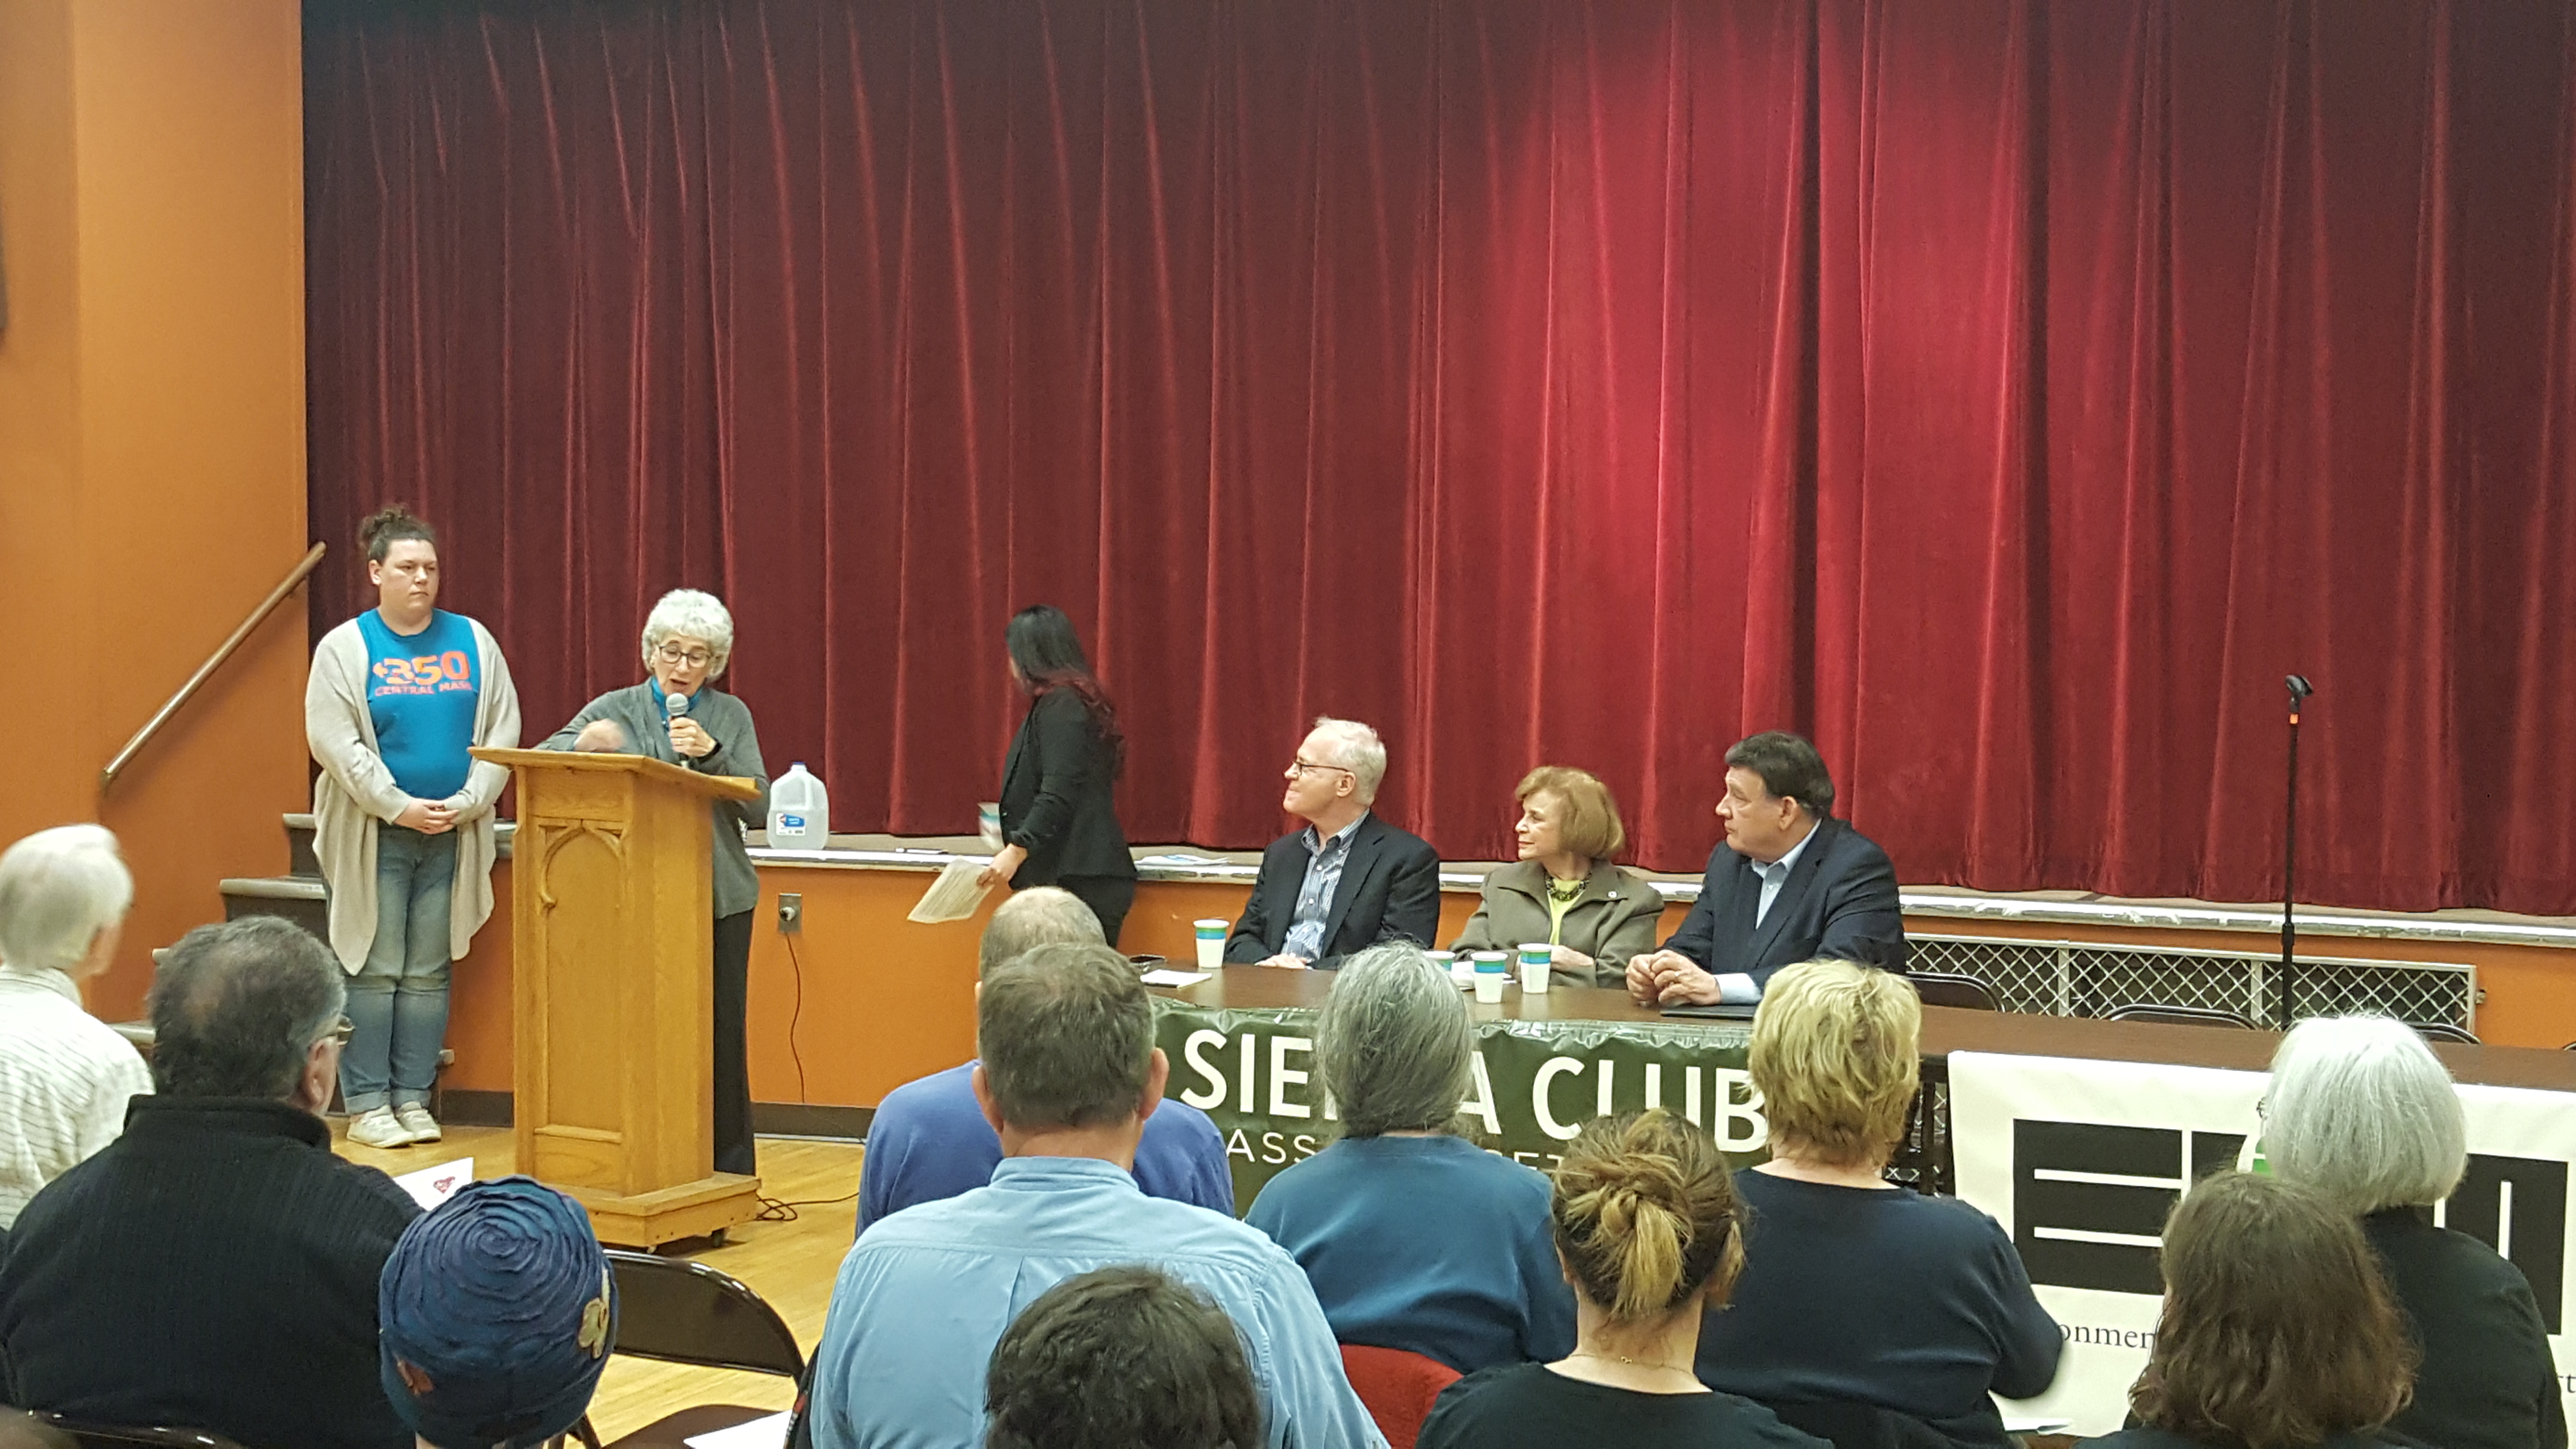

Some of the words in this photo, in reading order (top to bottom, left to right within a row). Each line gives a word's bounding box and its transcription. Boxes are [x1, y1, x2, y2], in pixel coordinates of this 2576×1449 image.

[384, 651, 469, 685] 350
[374, 685, 435, 696] CENTRAL
[1180, 1029, 1502, 1135] SIEA
